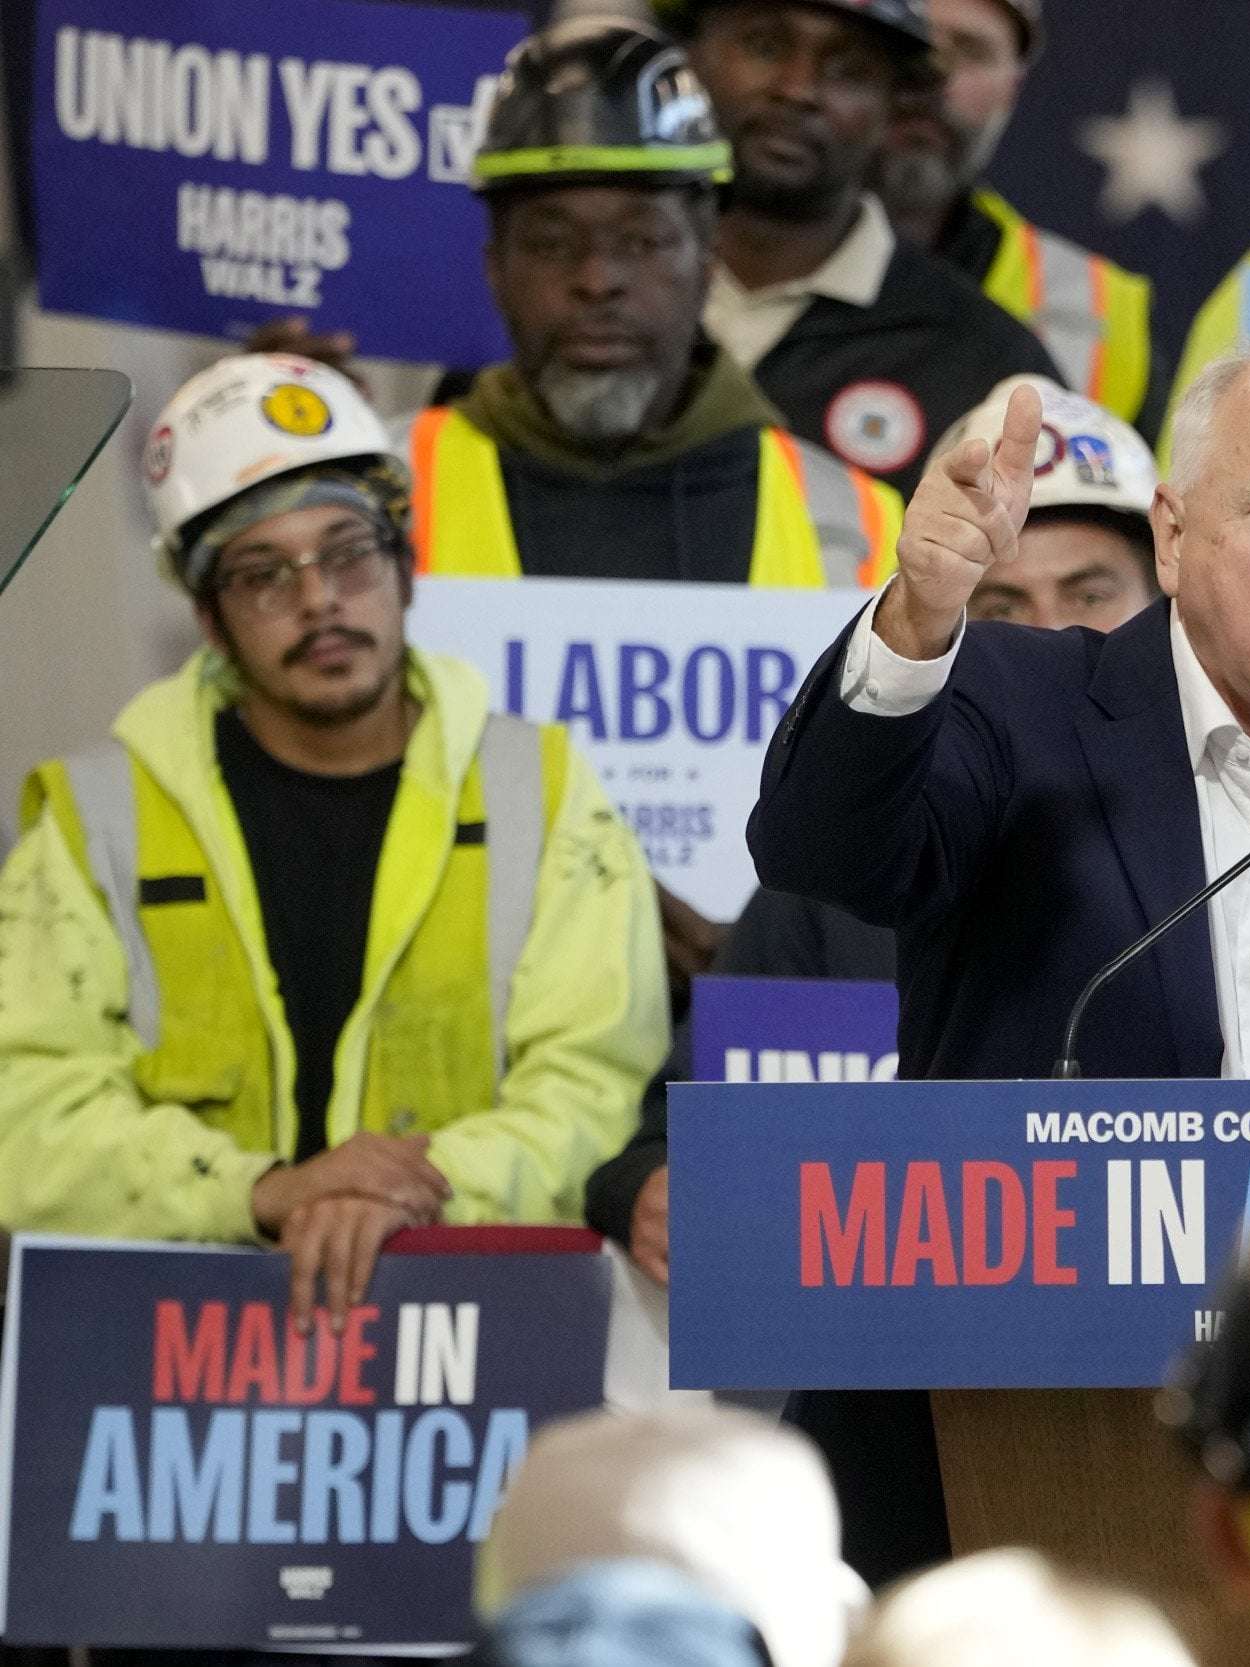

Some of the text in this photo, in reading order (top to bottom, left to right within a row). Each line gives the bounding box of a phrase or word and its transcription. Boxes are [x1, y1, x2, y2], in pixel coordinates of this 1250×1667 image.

[54, 25, 423, 180] UNION YES
[176, 181, 351, 270] HARRIS
[200, 258, 322, 308] WALZ
[506, 640, 797, 743] LABOR
[1026, 1111, 1204, 1143] MACOMB
[800, 1160, 1078, 1287] MADE
[1107, 1159, 1206, 1285] IN
[152, 1299, 480, 1406] MADE IN
[69, 1404, 529, 1545] AMERICA
